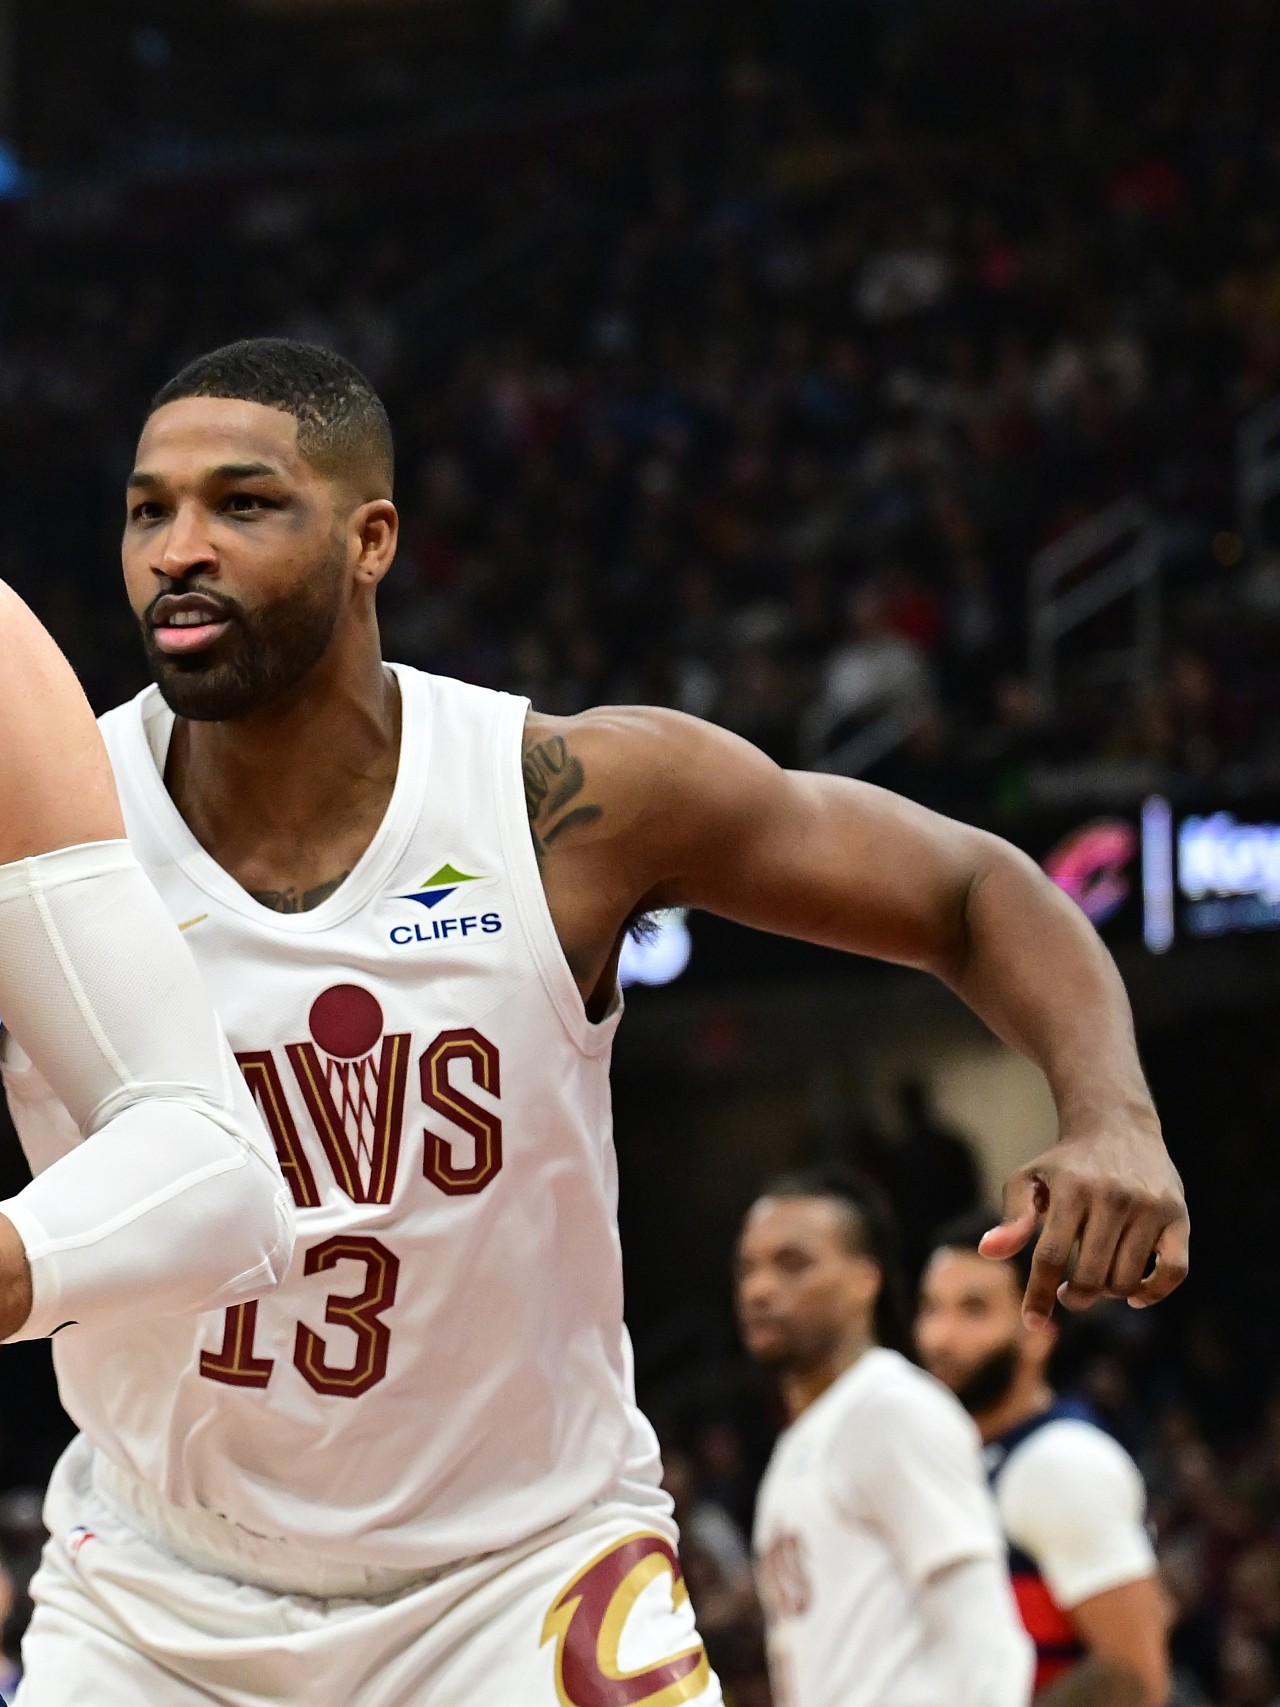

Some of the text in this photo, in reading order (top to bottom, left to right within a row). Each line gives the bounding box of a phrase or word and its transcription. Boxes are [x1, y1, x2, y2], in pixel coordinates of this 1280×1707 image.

[389, 912, 502, 945] CLIFFS
[234, 1027, 504, 1207] AVS
[199, 1234, 401, 1398] 13
